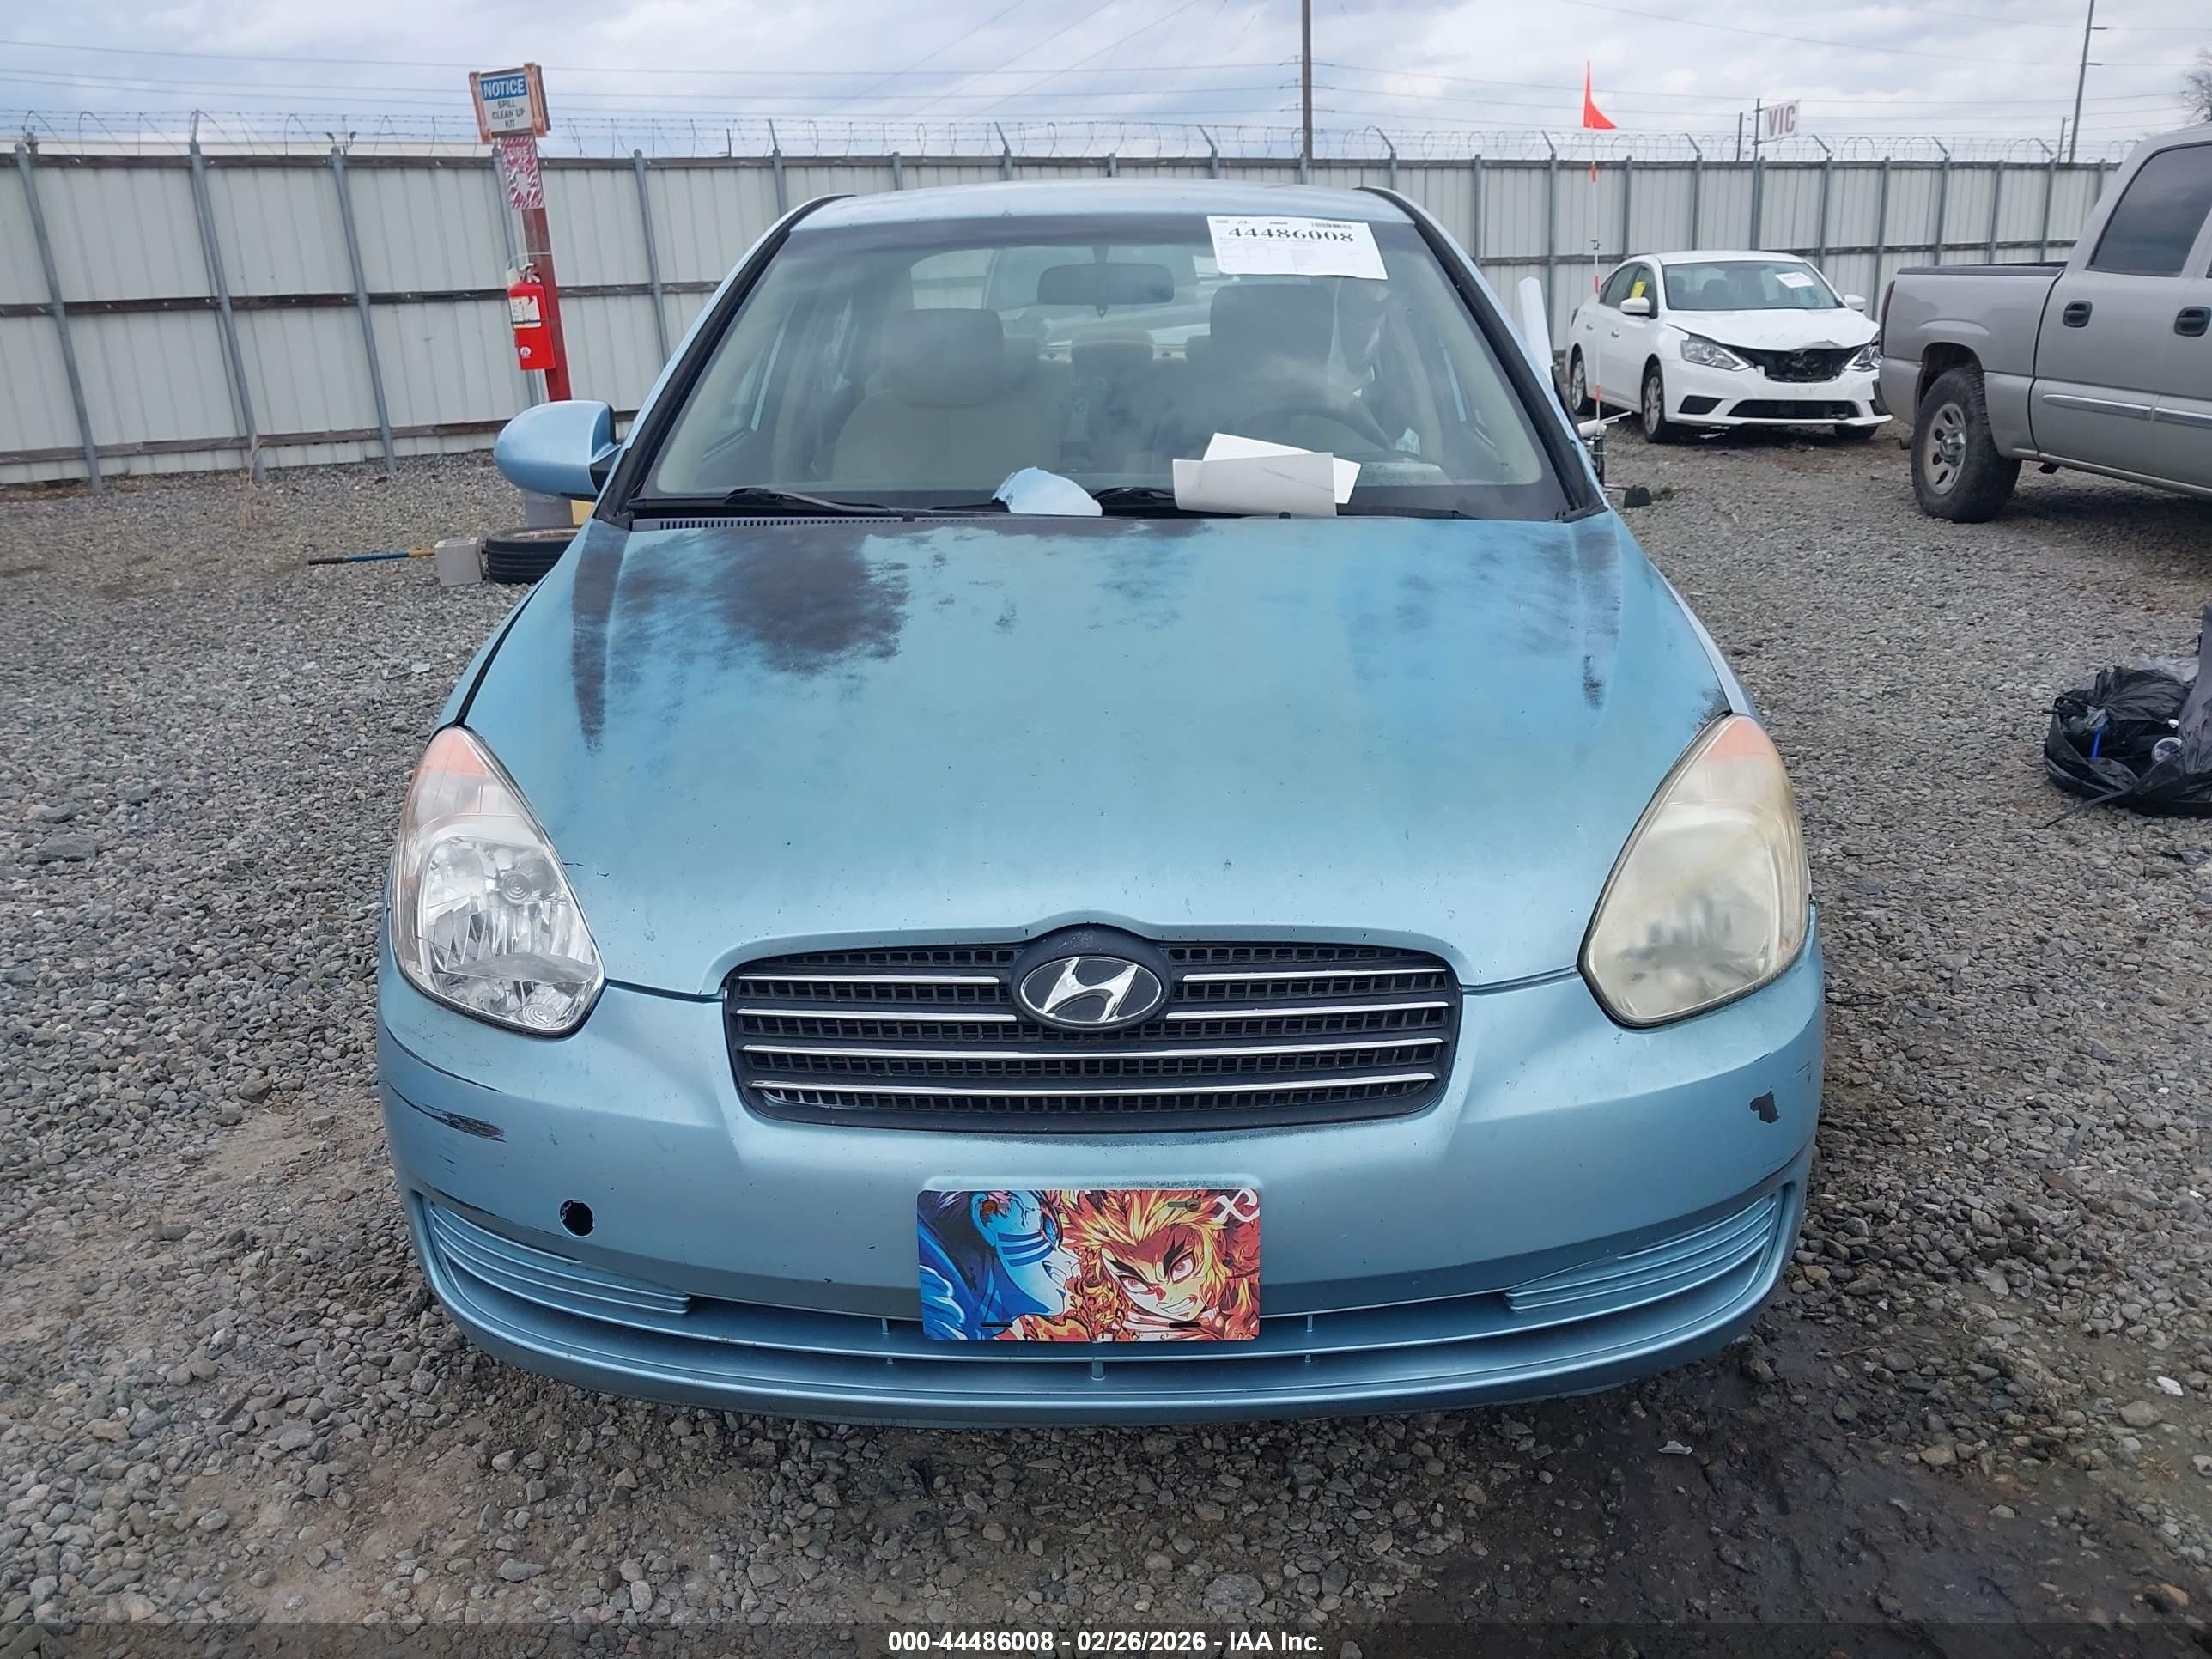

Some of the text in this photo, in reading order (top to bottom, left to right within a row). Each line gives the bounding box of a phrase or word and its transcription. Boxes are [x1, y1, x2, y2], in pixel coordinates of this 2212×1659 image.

[483, 78, 525, 97] NOTICE
[497, 99, 516, 108] SPILL
[492, 107, 526, 119] CLEAN UP
[505, 119, 515, 128] KIT
[1769, 104, 1796, 137] VIC
[1228, 228, 1354, 243] 44486008
